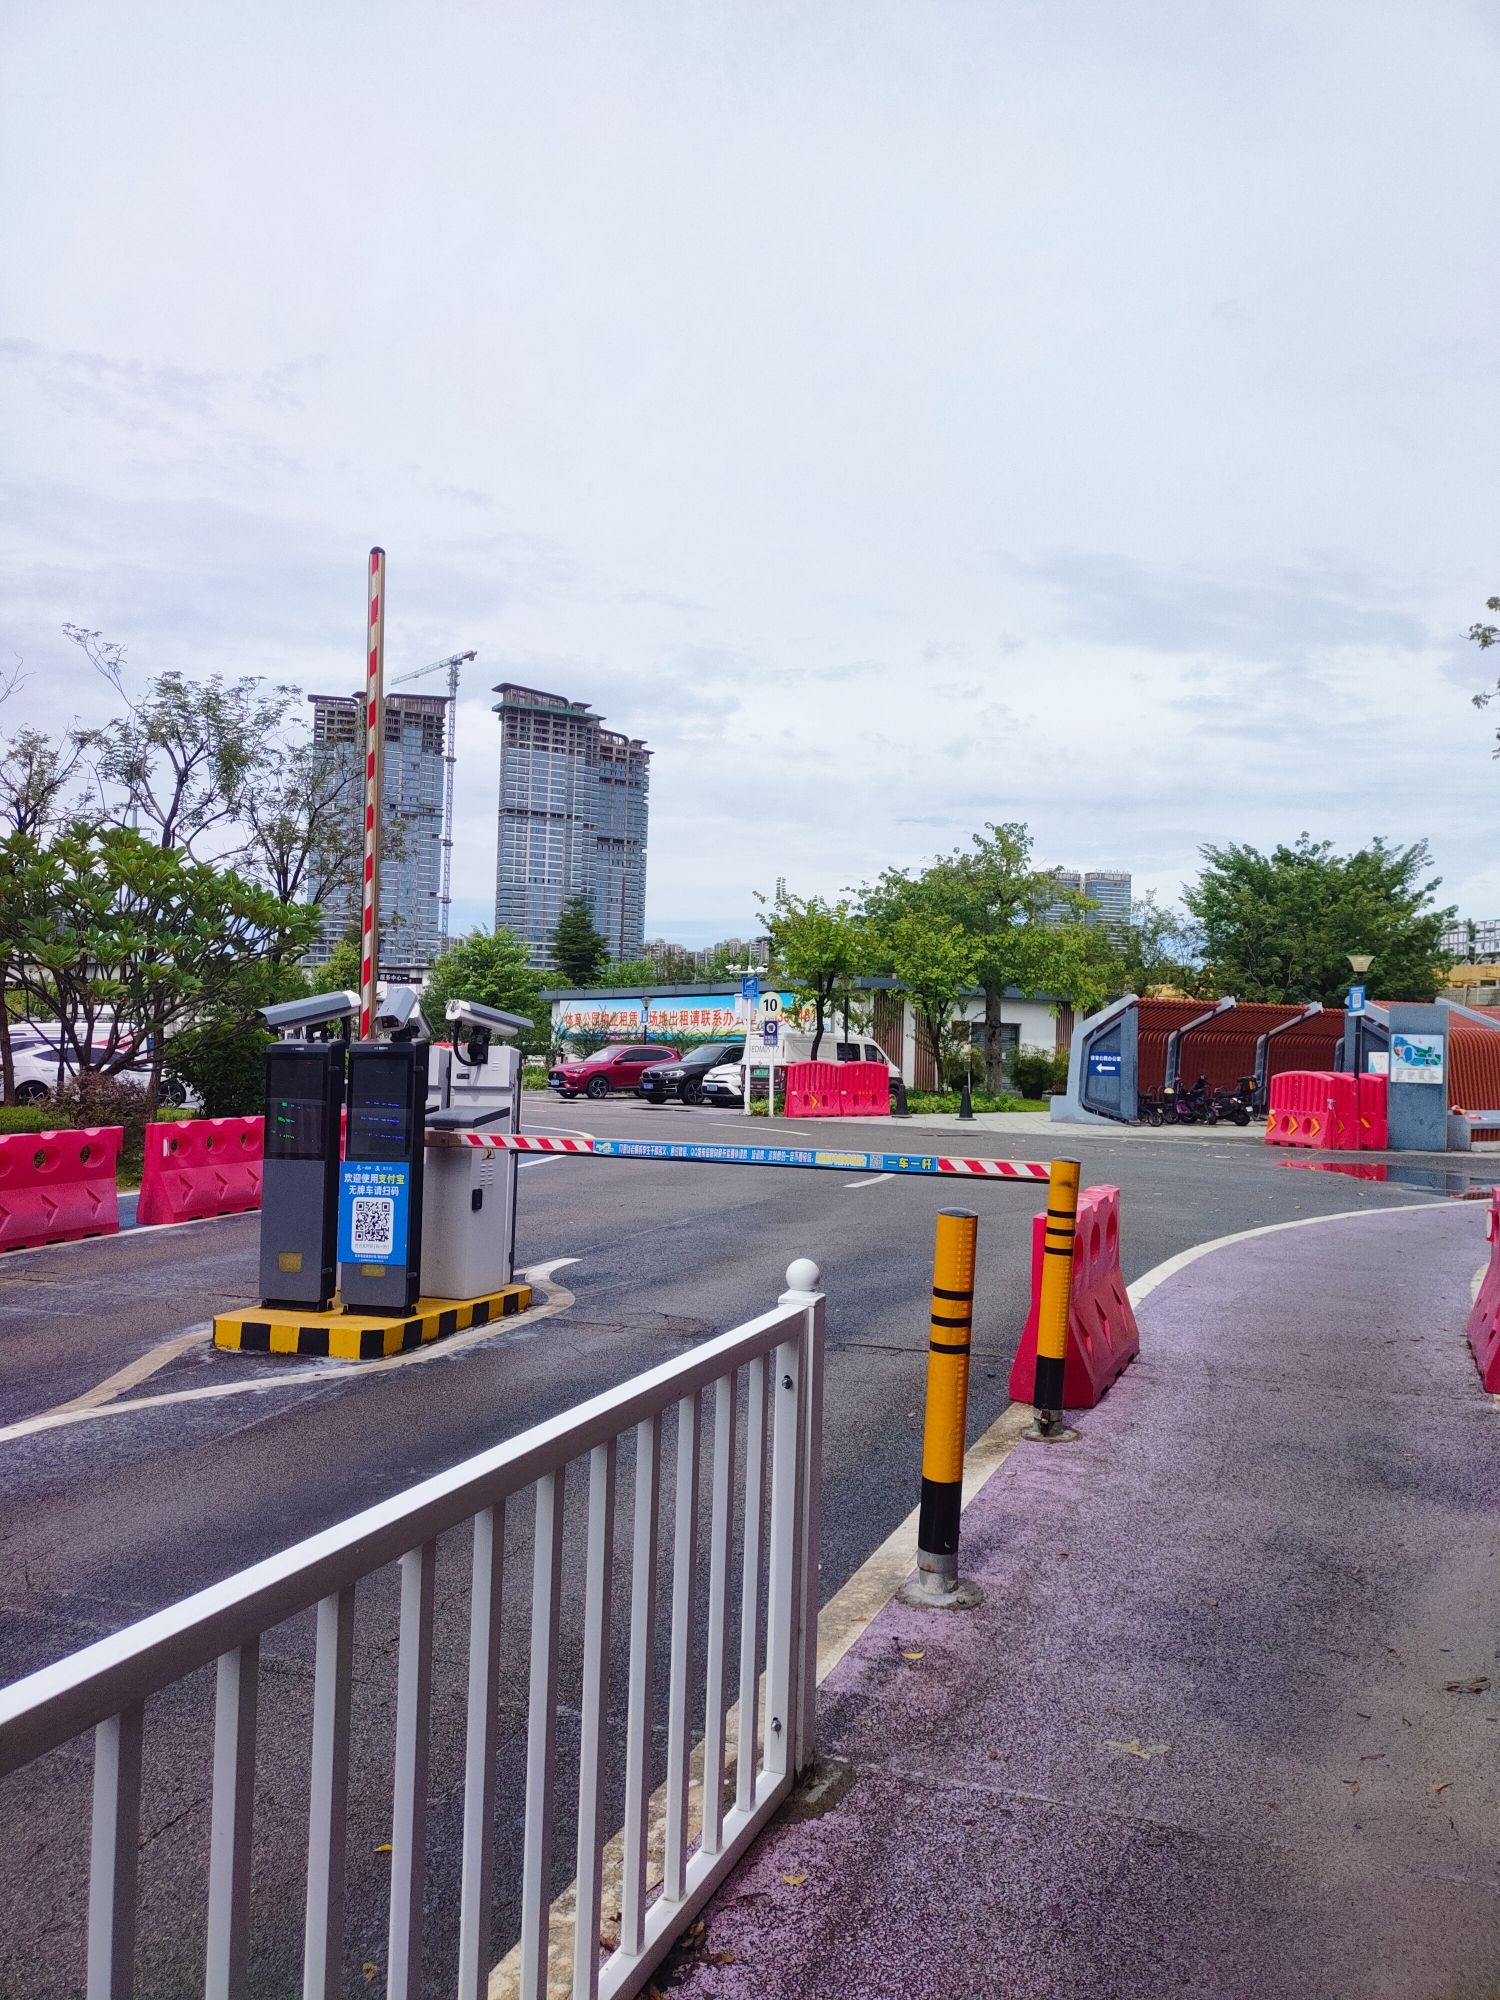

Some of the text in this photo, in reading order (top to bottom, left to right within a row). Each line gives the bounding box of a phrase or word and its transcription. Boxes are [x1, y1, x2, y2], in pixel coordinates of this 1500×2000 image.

[763, 999, 778, 1012] 10
[564, 1008, 758, 1027] 体育公园物业租赁场地出租请联系办室
[343, 1173, 405, 1185] 欢迎使用支付宝
[348, 1185, 400, 1196] 无牌车请扫码
